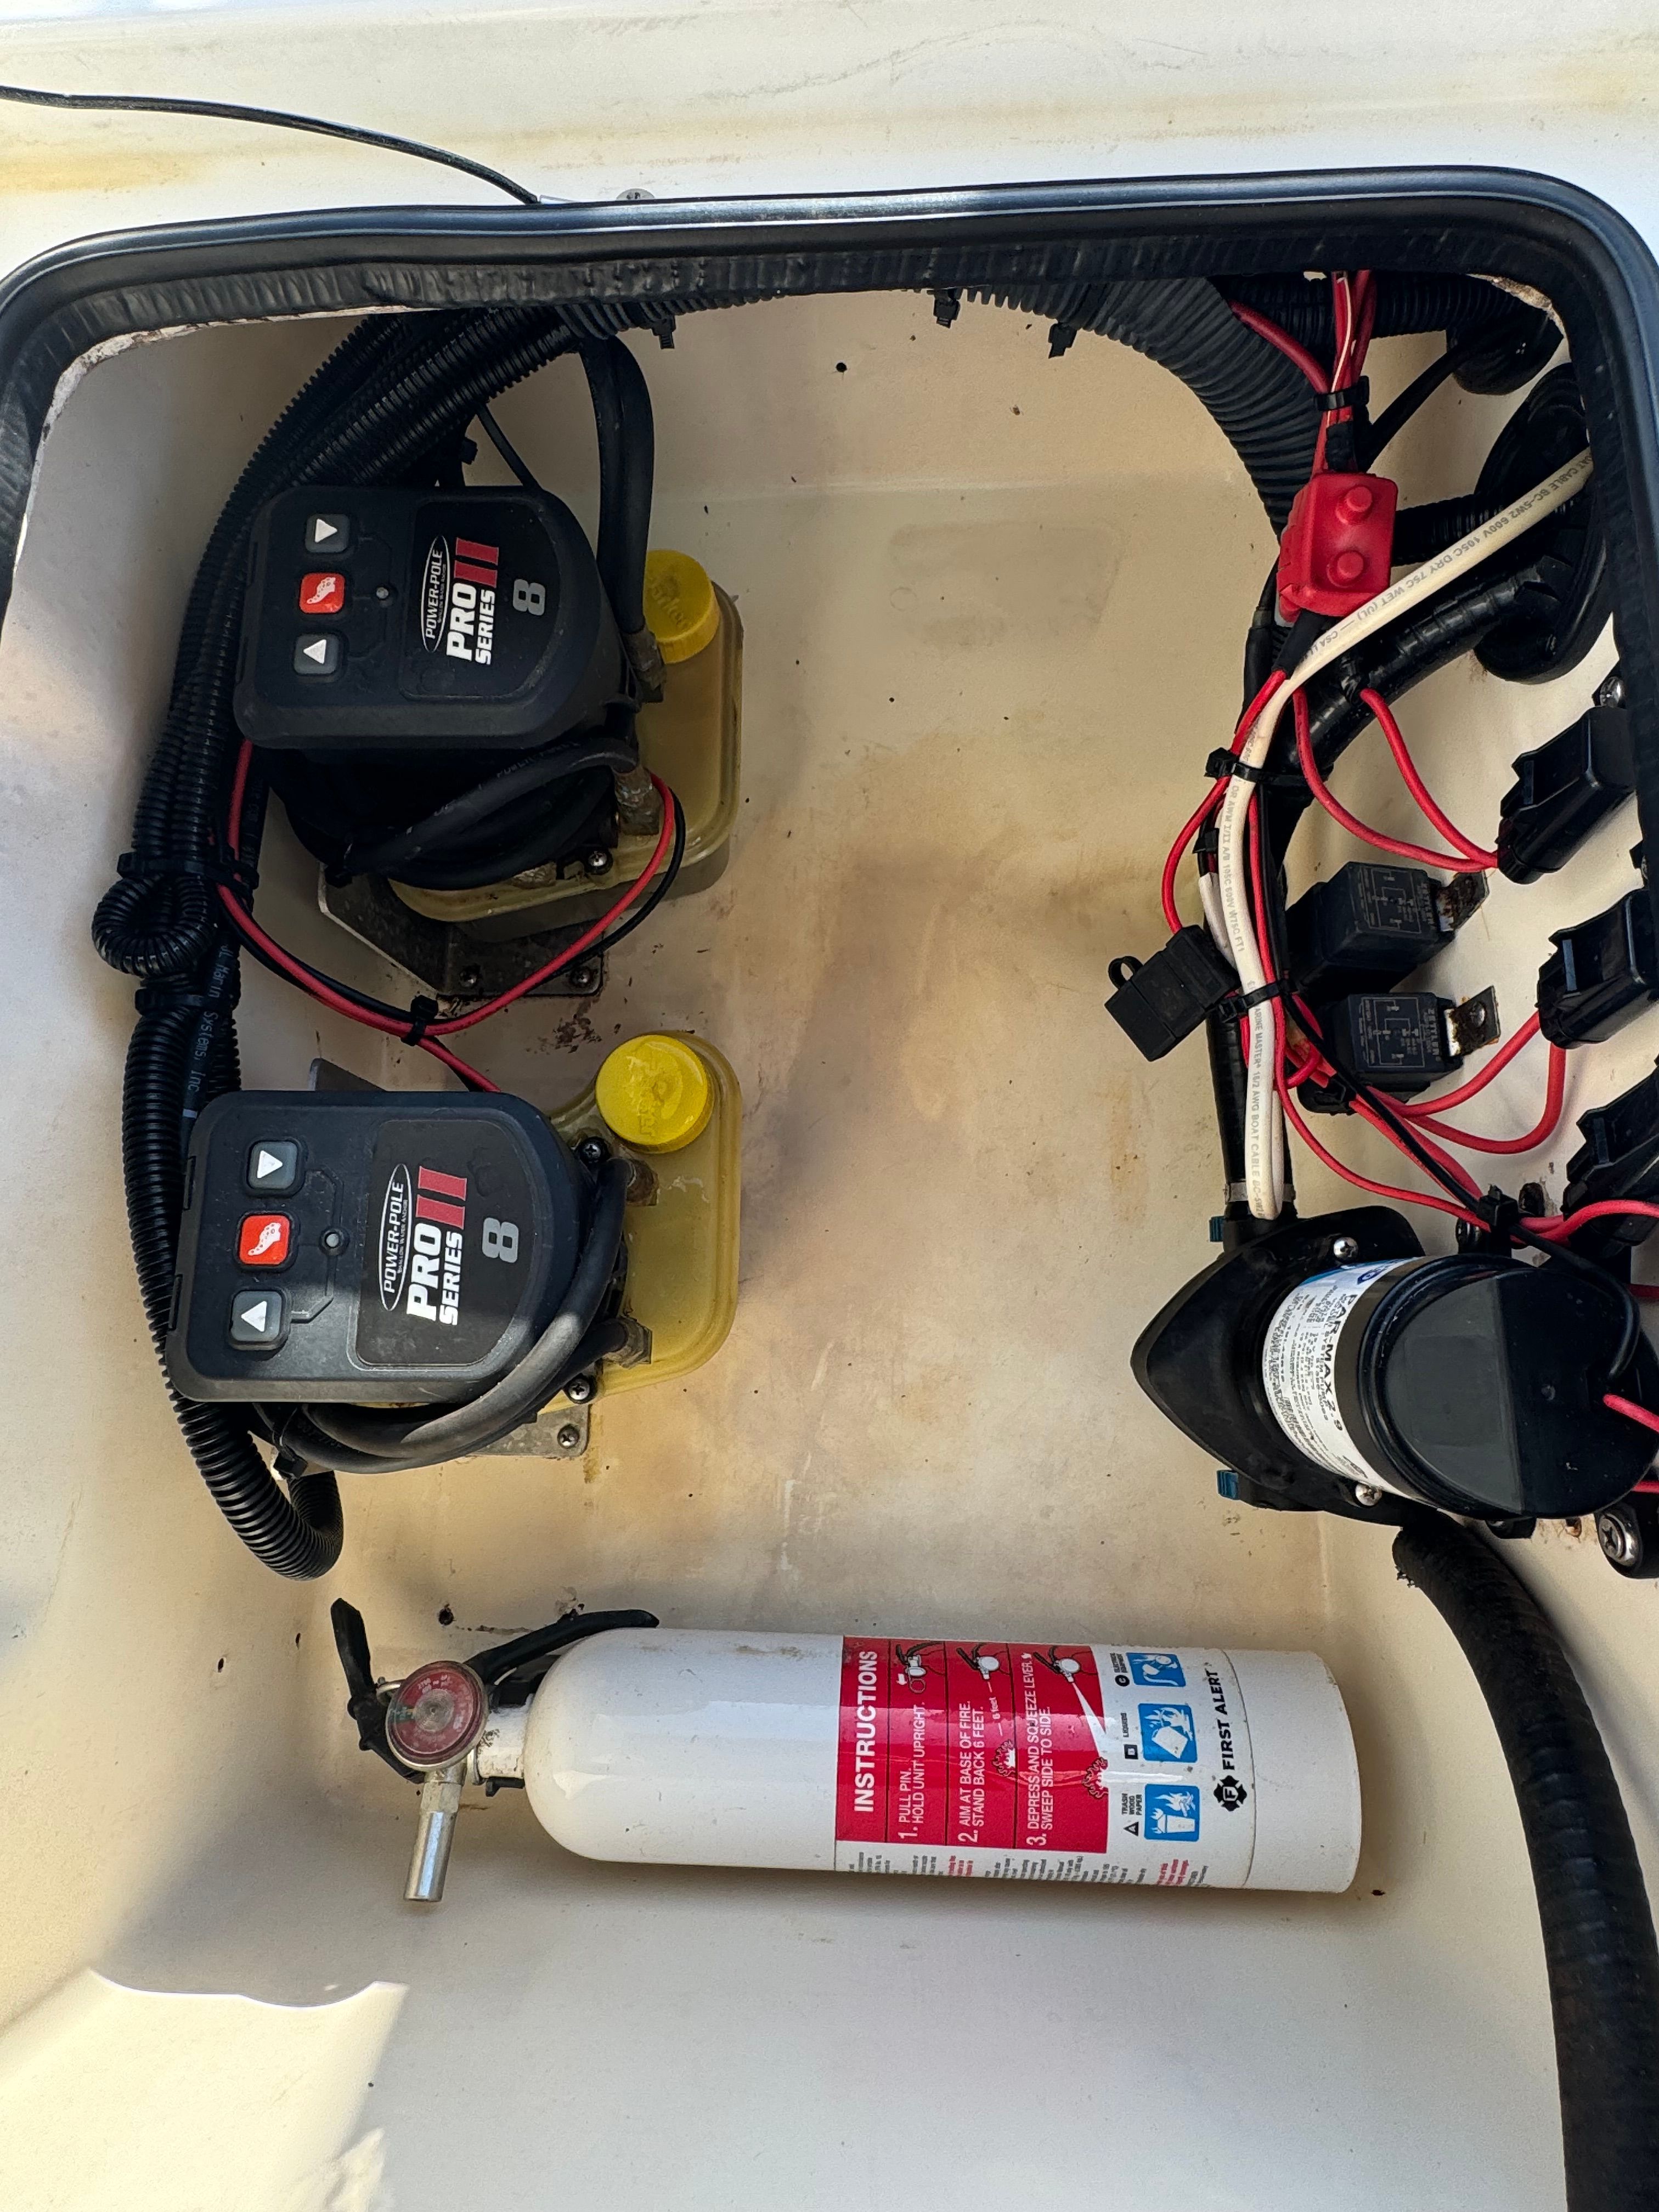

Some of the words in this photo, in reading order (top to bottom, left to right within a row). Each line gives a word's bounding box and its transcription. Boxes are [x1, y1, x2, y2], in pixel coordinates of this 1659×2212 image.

[1548, 468, 1578, 490] CABLE
[1509, 489, 1550, 518] BC-5W2
[1483, 517, 1509, 538] 600V
[1453, 537, 1480, 556] 105C
[1430, 554, 1453, 574] DRY
[1406, 571, 1427, 588] 75C
[426, 550, 443, 639] POWER-POLE
[513, 579, 546, 616] 8
[1381, 586, 1404, 606] WET
[447, 583, 476, 661] PRO
[1357, 601, 1378, 620] (UL)
[476, 589, 495, 664] SERIES
[1319, 631, 1339, 647] CSA
[208, 963, 230, 998] Marin
[1254, 1008, 1263, 1031] ARINE
[194, 1011, 218, 1060] Systems,
[188, 1070, 206, 1093] Inc
[1251, 1090, 1260, 1111] AWG
[1250, 1114, 1260, 1141] BOAT
[1251, 1143, 1260, 1177] CABLE
[384, 1182, 404, 1293] POWER-POLE
[482, 1217, 519, 1263] 8
[407, 1223, 442, 1321] PRO
[439, 1231, 462, 1325] SERIES
[1324, 1294, 1358, 1396] PAR-MAX
[1022, 1660, 1036, 1688] LEVER.
[1206, 1669, 1227, 1714] ALERT
[959, 1701, 970, 1728] FIRE.
[972, 1707, 984, 1737] FEET.
[1024, 1692, 1039, 1743] SQUEEZE
[1039, 1707, 1052, 1735] SIDE.
[854, 1651, 878, 1812] INSTRUCTIONS
[912, 1701, 926, 1758] UPRIGHT.
[960, 1731, 971, 1748] OF
[1040, 1739, 1052, 1756] TO
[1217, 1720, 1235, 1770] FIRST
[960, 1752, 972, 1784] BASE
[973, 1751, 985, 1786] BACK
[1027, 1748, 1039, 1773] AND
[1040, 1761, 1052, 1786] SIDE
[899, 1768, 912, 1791] PIN.
[912, 1761, 925, 1789] UNIT
[899, 1795, 911, 1822] PULL
[912, 1792, 924, 1824] HOLD
[960, 1787, 971, 1803] AT
[973, 1789, 984, 1826] STAND
[1028, 1776, 1040, 1829] DEPRESS
[960, 1807, 971, 1826] AIM
[1041, 1790, 1053, 1830] SWEEP
[898, 1826, 918, 1839] 1.
[958, 1830, 979, 1842] 2.
[1028, 1833, 1047, 1846] 3.
